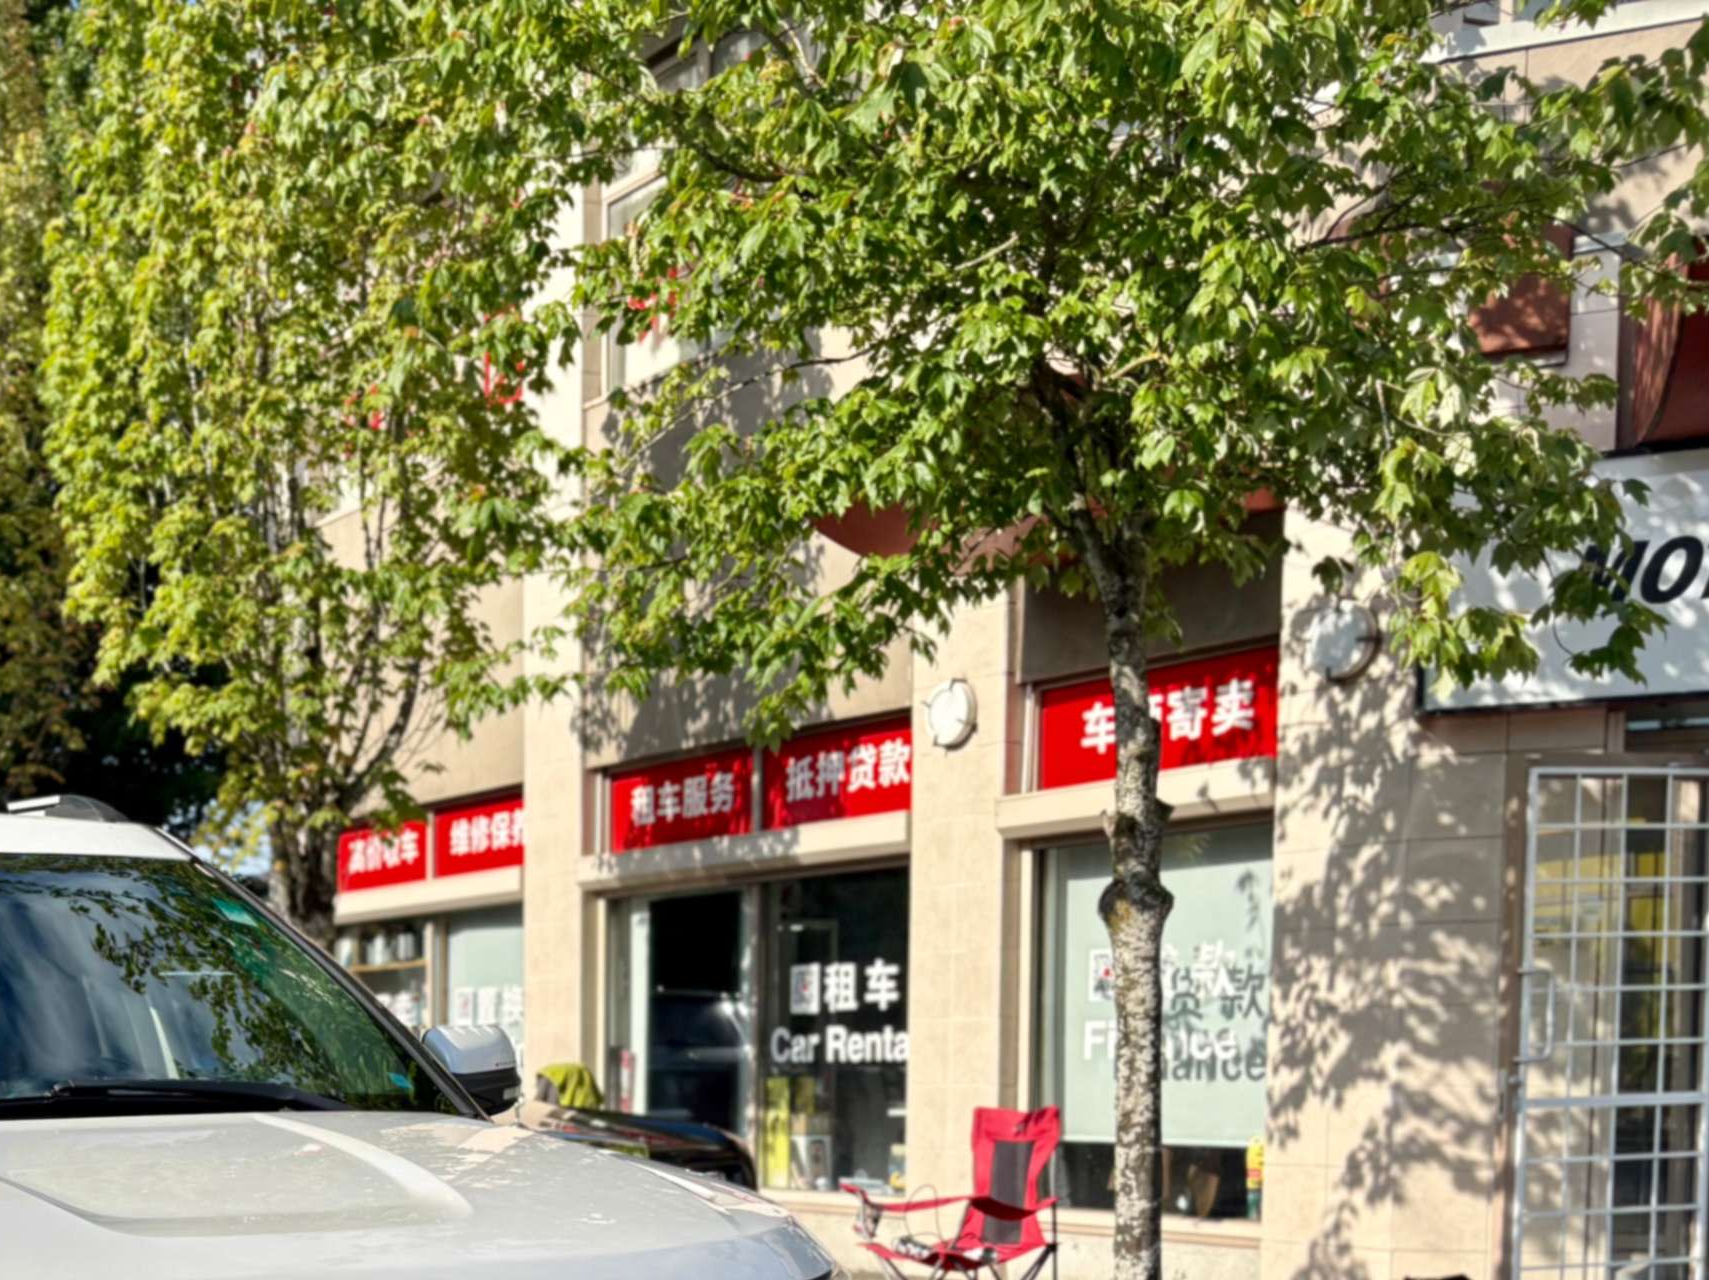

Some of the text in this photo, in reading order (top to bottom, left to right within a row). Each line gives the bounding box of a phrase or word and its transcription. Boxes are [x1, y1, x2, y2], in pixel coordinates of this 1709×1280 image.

[786, 738, 910, 802] 抵押贷款
[631, 771, 735, 826] 租车服务
[771, 1027, 820, 1063] Car
